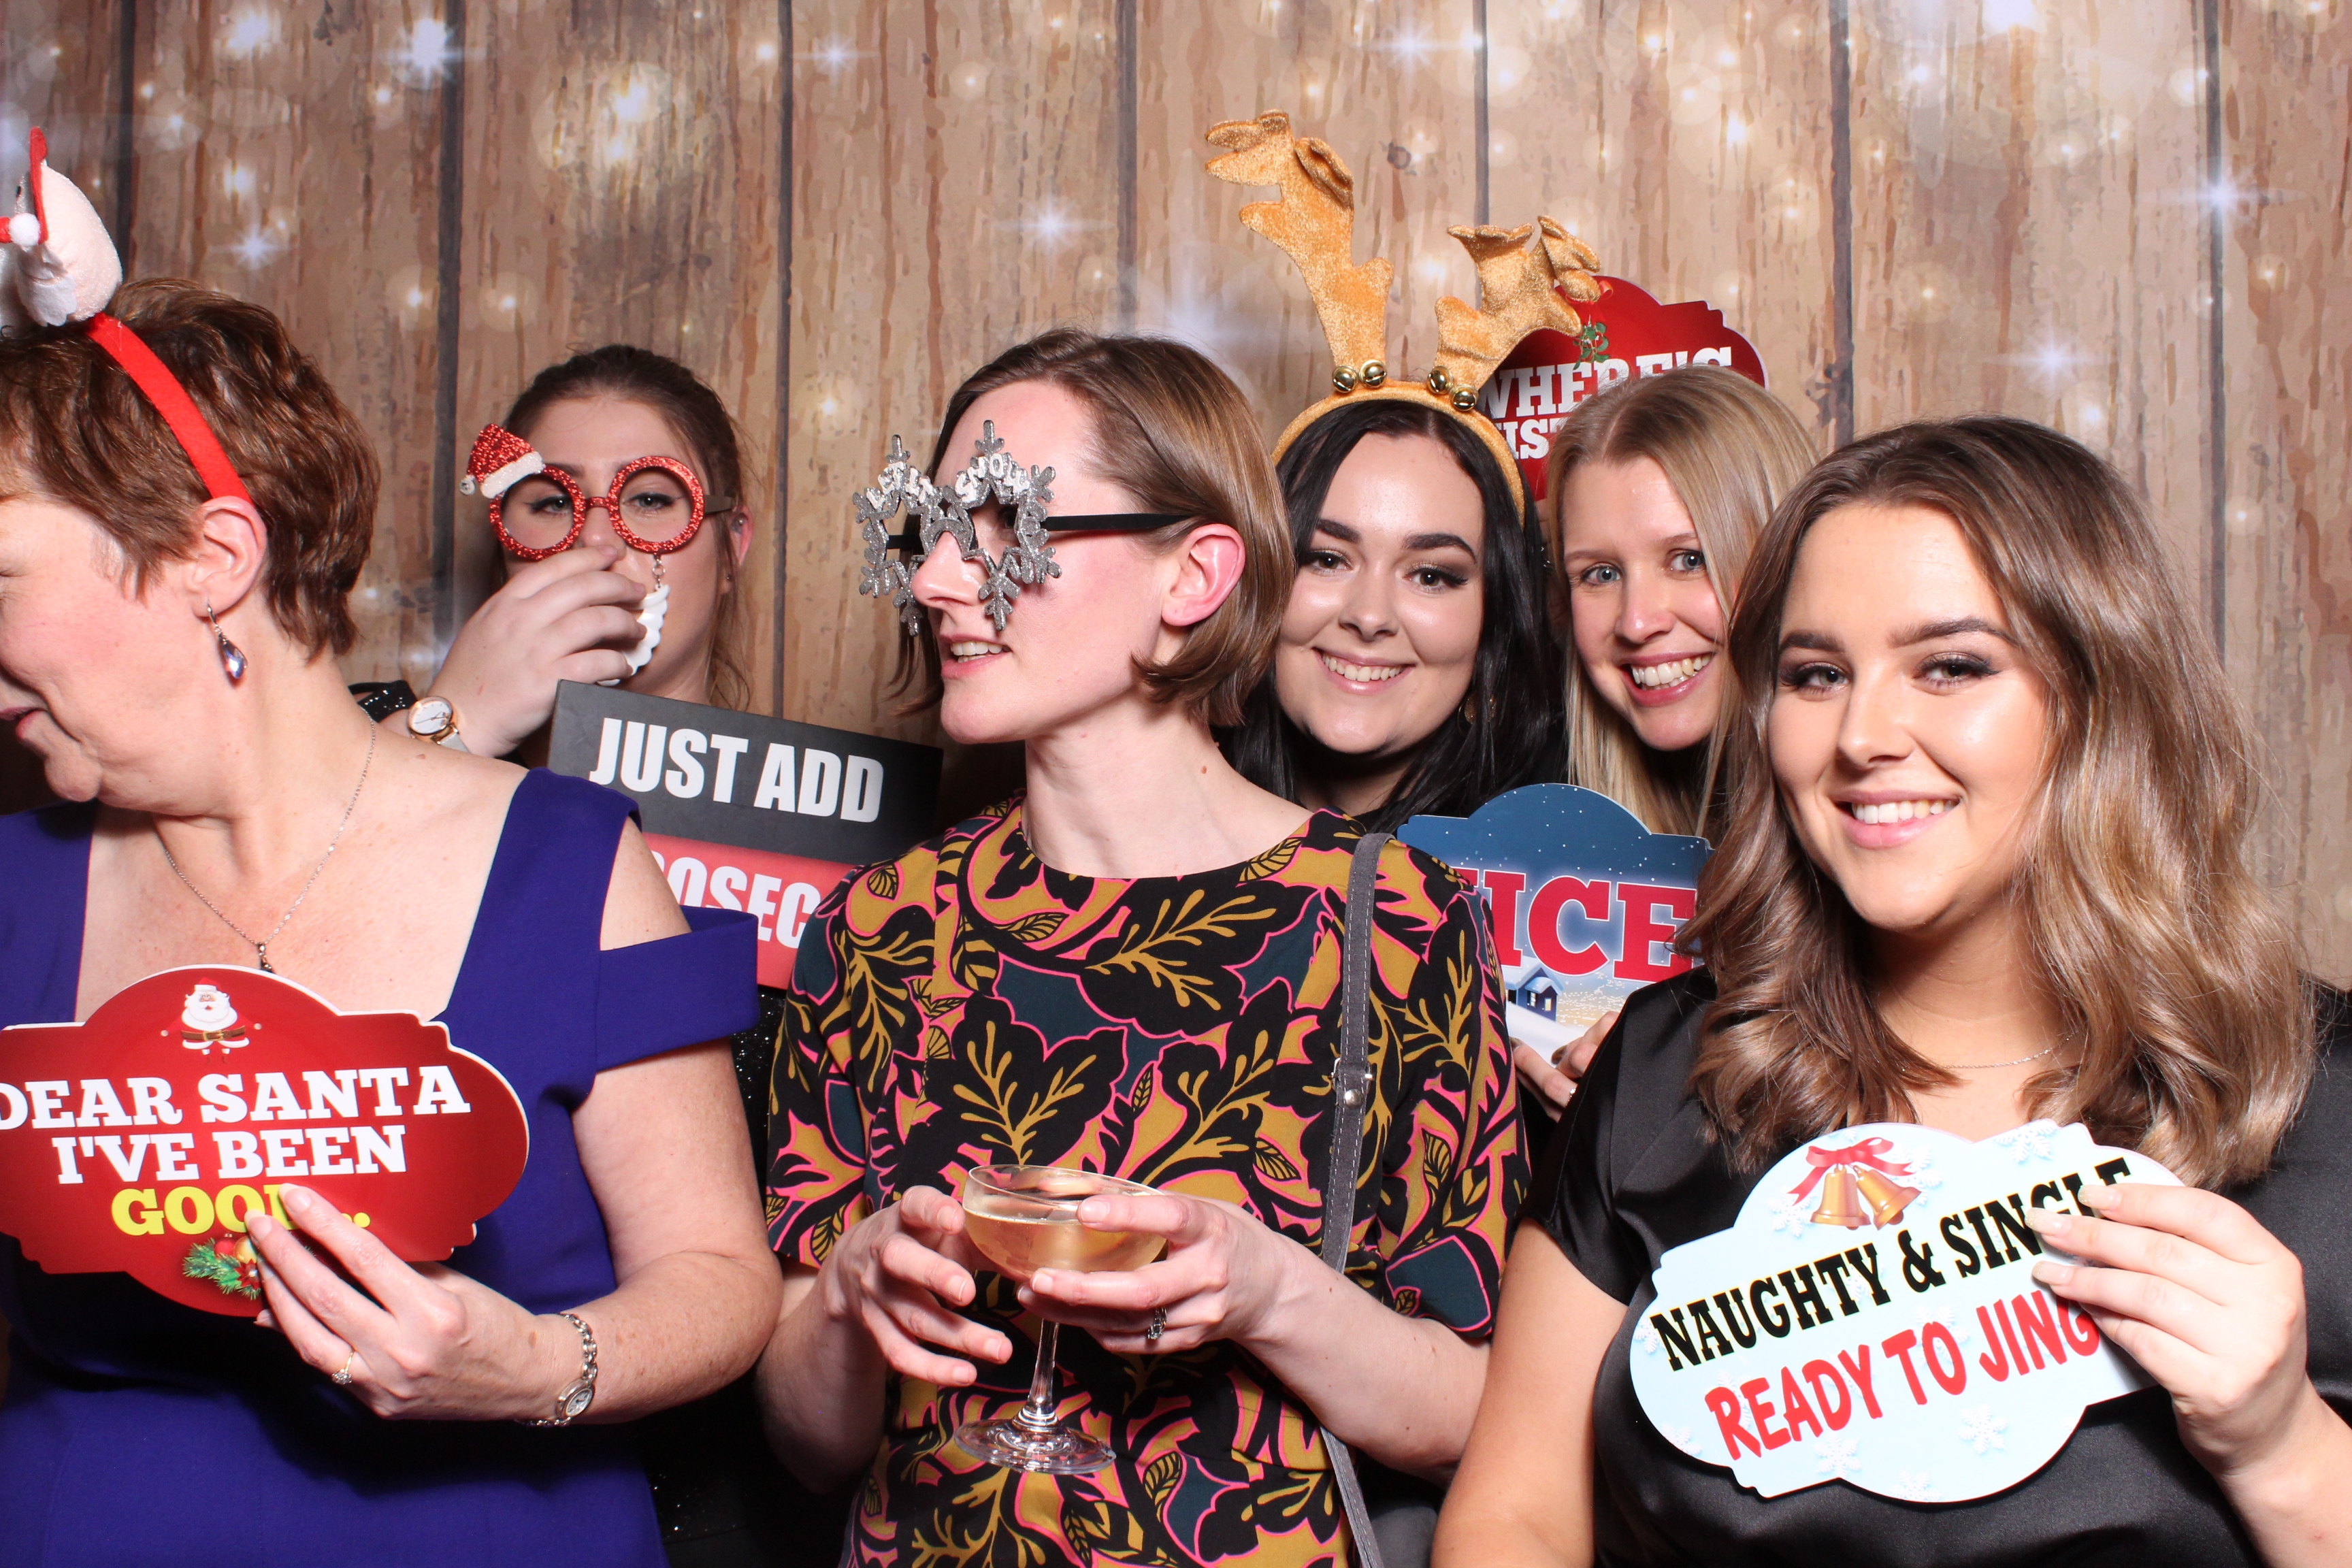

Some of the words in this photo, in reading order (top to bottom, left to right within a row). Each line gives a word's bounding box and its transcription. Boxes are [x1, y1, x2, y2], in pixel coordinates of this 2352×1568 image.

[589, 717, 748, 803] JUST
[753, 742, 884, 823] ADD
[1450, 866, 1697, 983] ICE
[0, 1077, 183, 1130] DEAR
[197, 1066, 471, 1123] SANTA
[52, 1133, 199, 1184] I'VE
[212, 1125, 407, 1179] BEEN
[1650, 1242, 1891, 1371] NAUGHTY
[1898, 1229, 1946, 1293] &
[1705, 1343, 1884, 1460] READY
[1882, 1321, 1967, 1405] TO
